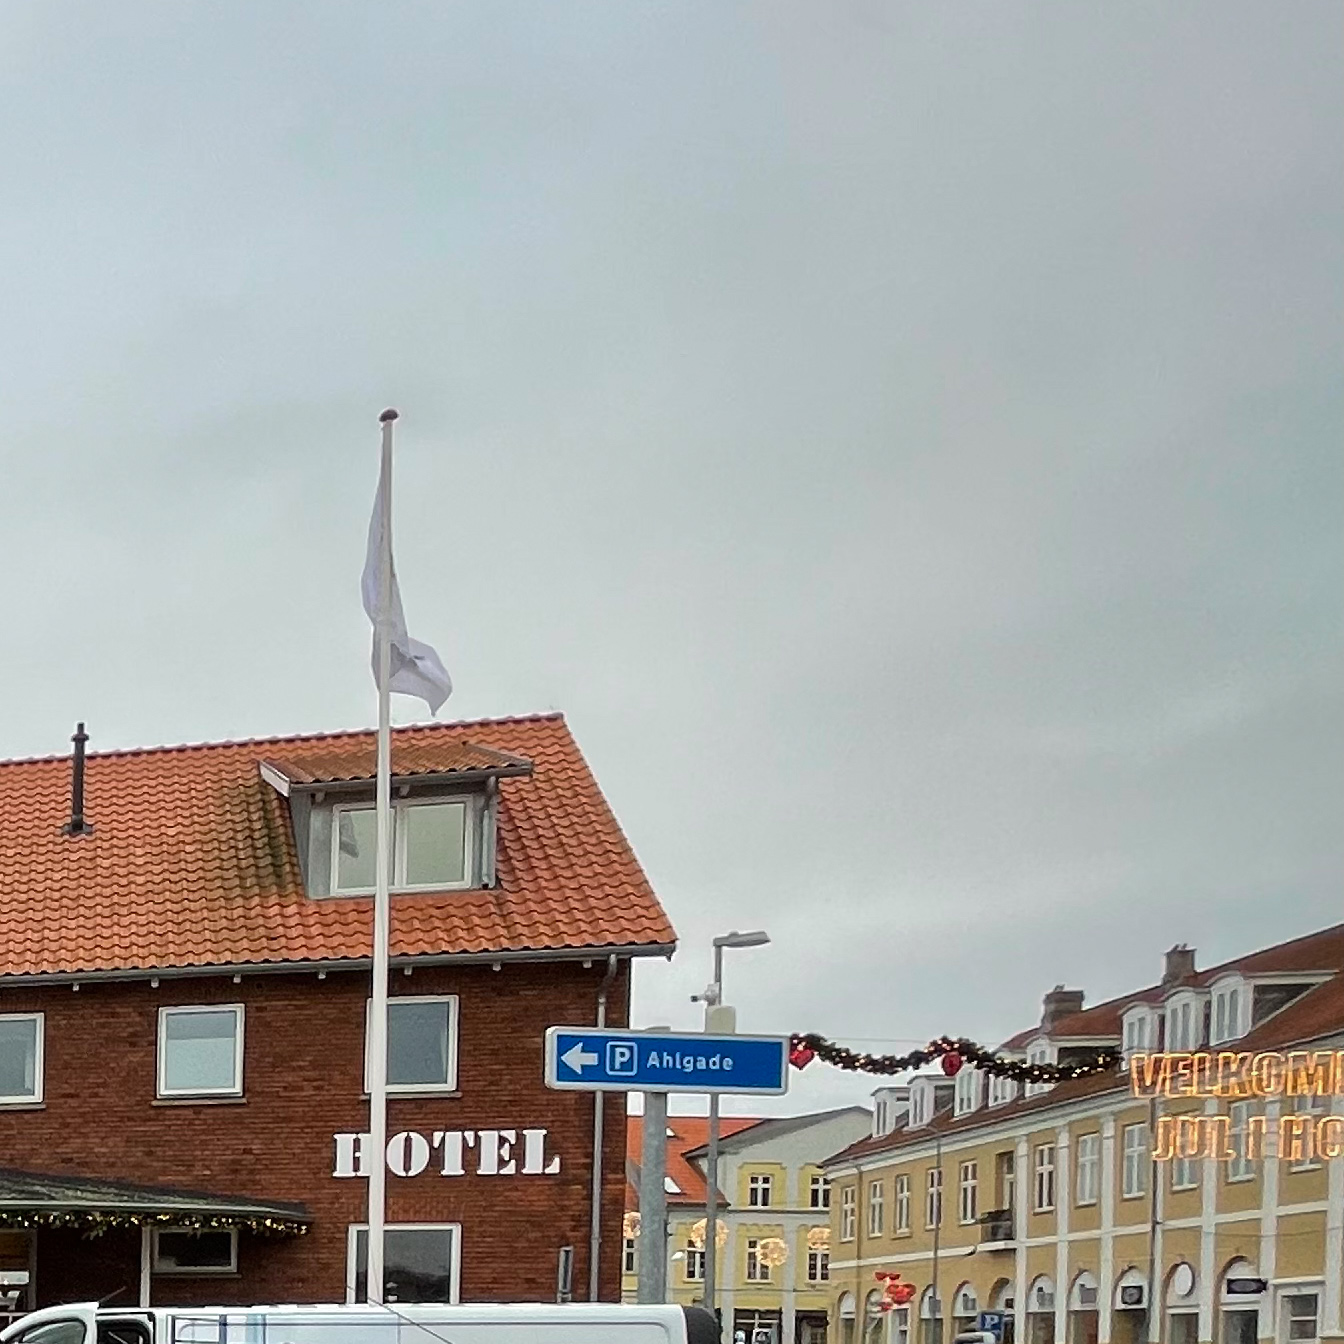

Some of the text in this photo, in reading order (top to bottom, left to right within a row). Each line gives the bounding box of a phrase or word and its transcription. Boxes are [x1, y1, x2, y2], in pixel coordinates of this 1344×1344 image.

[614, 1046, 733, 1073] P Ahlgade
[1130, 1051, 1344, 1098] VELKOM
[332, 1129, 561, 1177] HOTEL
[1152, 1115, 1237, 1161] JUL
[1248, 1115, 1267, 1160] I
[983, 1314, 999, 1329] P
